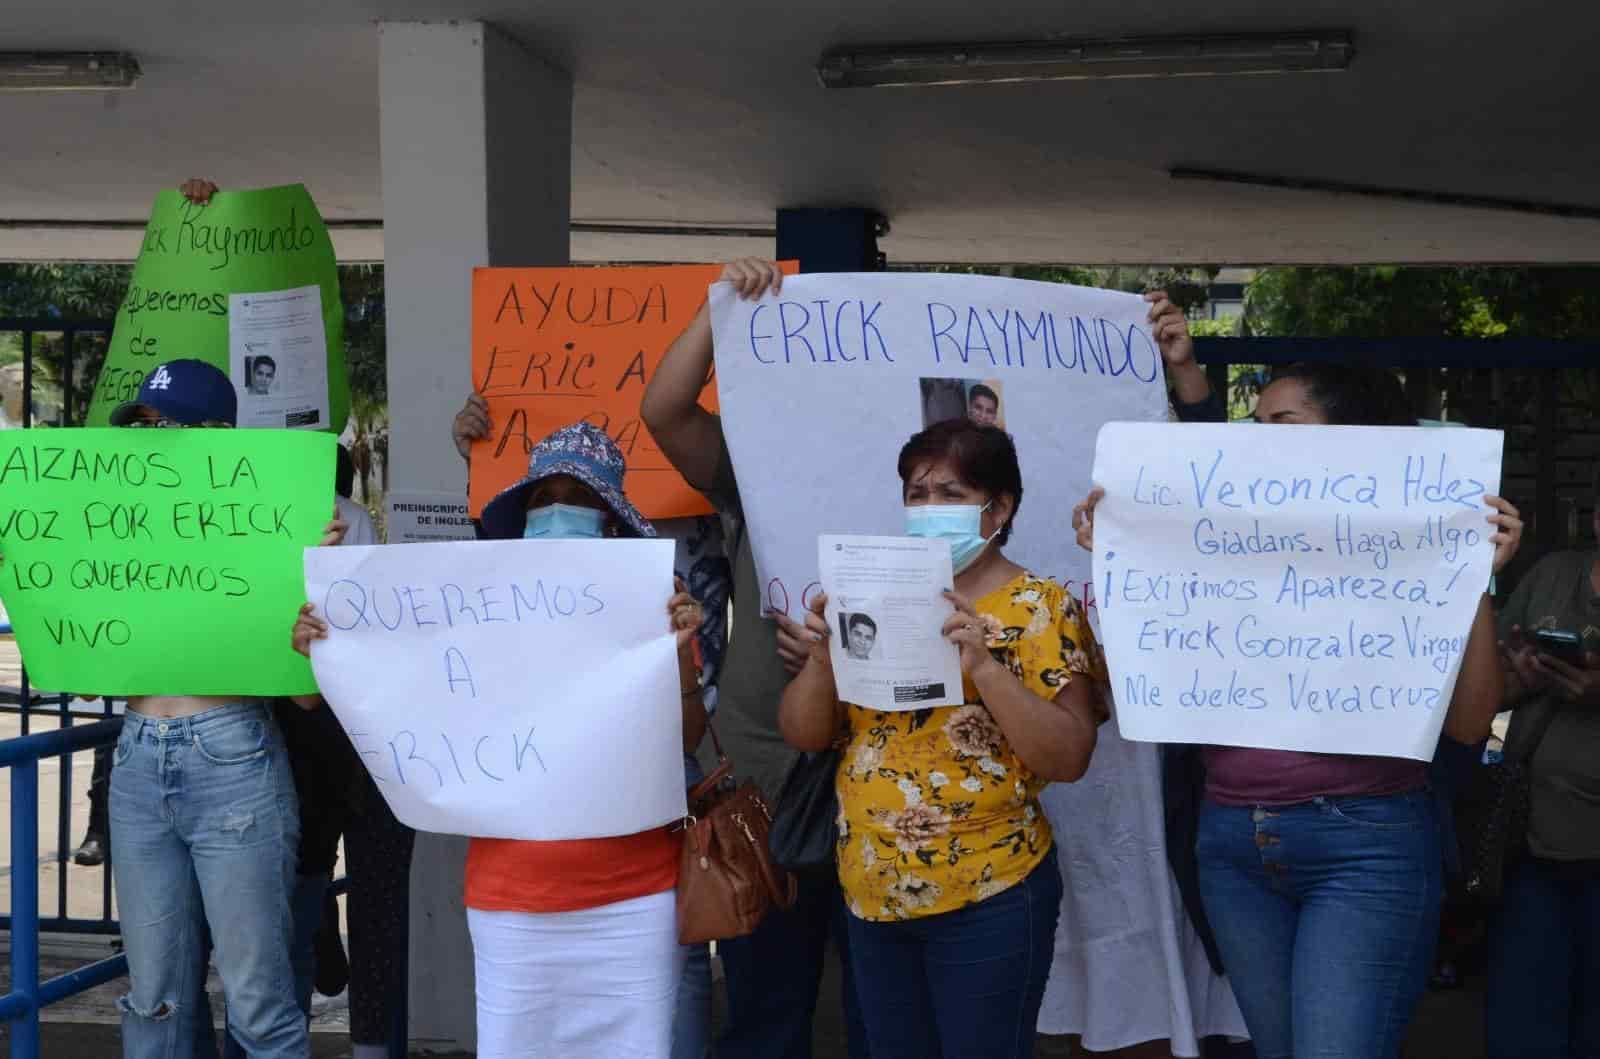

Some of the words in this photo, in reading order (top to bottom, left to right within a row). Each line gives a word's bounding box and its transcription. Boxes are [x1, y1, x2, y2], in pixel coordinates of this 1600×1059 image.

[177, 199, 315, 270] Raymundo
[494, 281, 668, 330] AYUDA
[129, 328, 157, 356] de
[750, 299, 895, 366] ERICK
[927, 302, 1158, 384] RAYMUNDO
[149, 365, 172, 390] LA
[479, 342, 597, 393] ERIC
[208, 455, 259, 489] LA
[1133, 464, 1182, 506] Lic.
[1190, 449, 1381, 509] Veronica
[1402, 453, 1488, 510] Hdez
[85, 501, 153, 541] POR
[173, 501, 293, 541] ERICK
[417, 515, 432, 525] DE
[1335, 513, 1402, 569] Haga
[1415, 516, 1481, 562] Algo
[14, 560, 53, 591] LO
[70, 559, 250, 597] QUEREMOS
[325, 578, 605, 631] QUEREMOS
[44, 617, 132, 649] VIVO
[1138, 618, 1226, 660] Erick
[1235, 614, 1395, 660] Gonzalez
[444, 646, 477, 698] A
[1125, 673, 1162, 711] Me
[1288, 668, 1441, 714] Veracruz
[349, 726, 547, 788] ERICK
